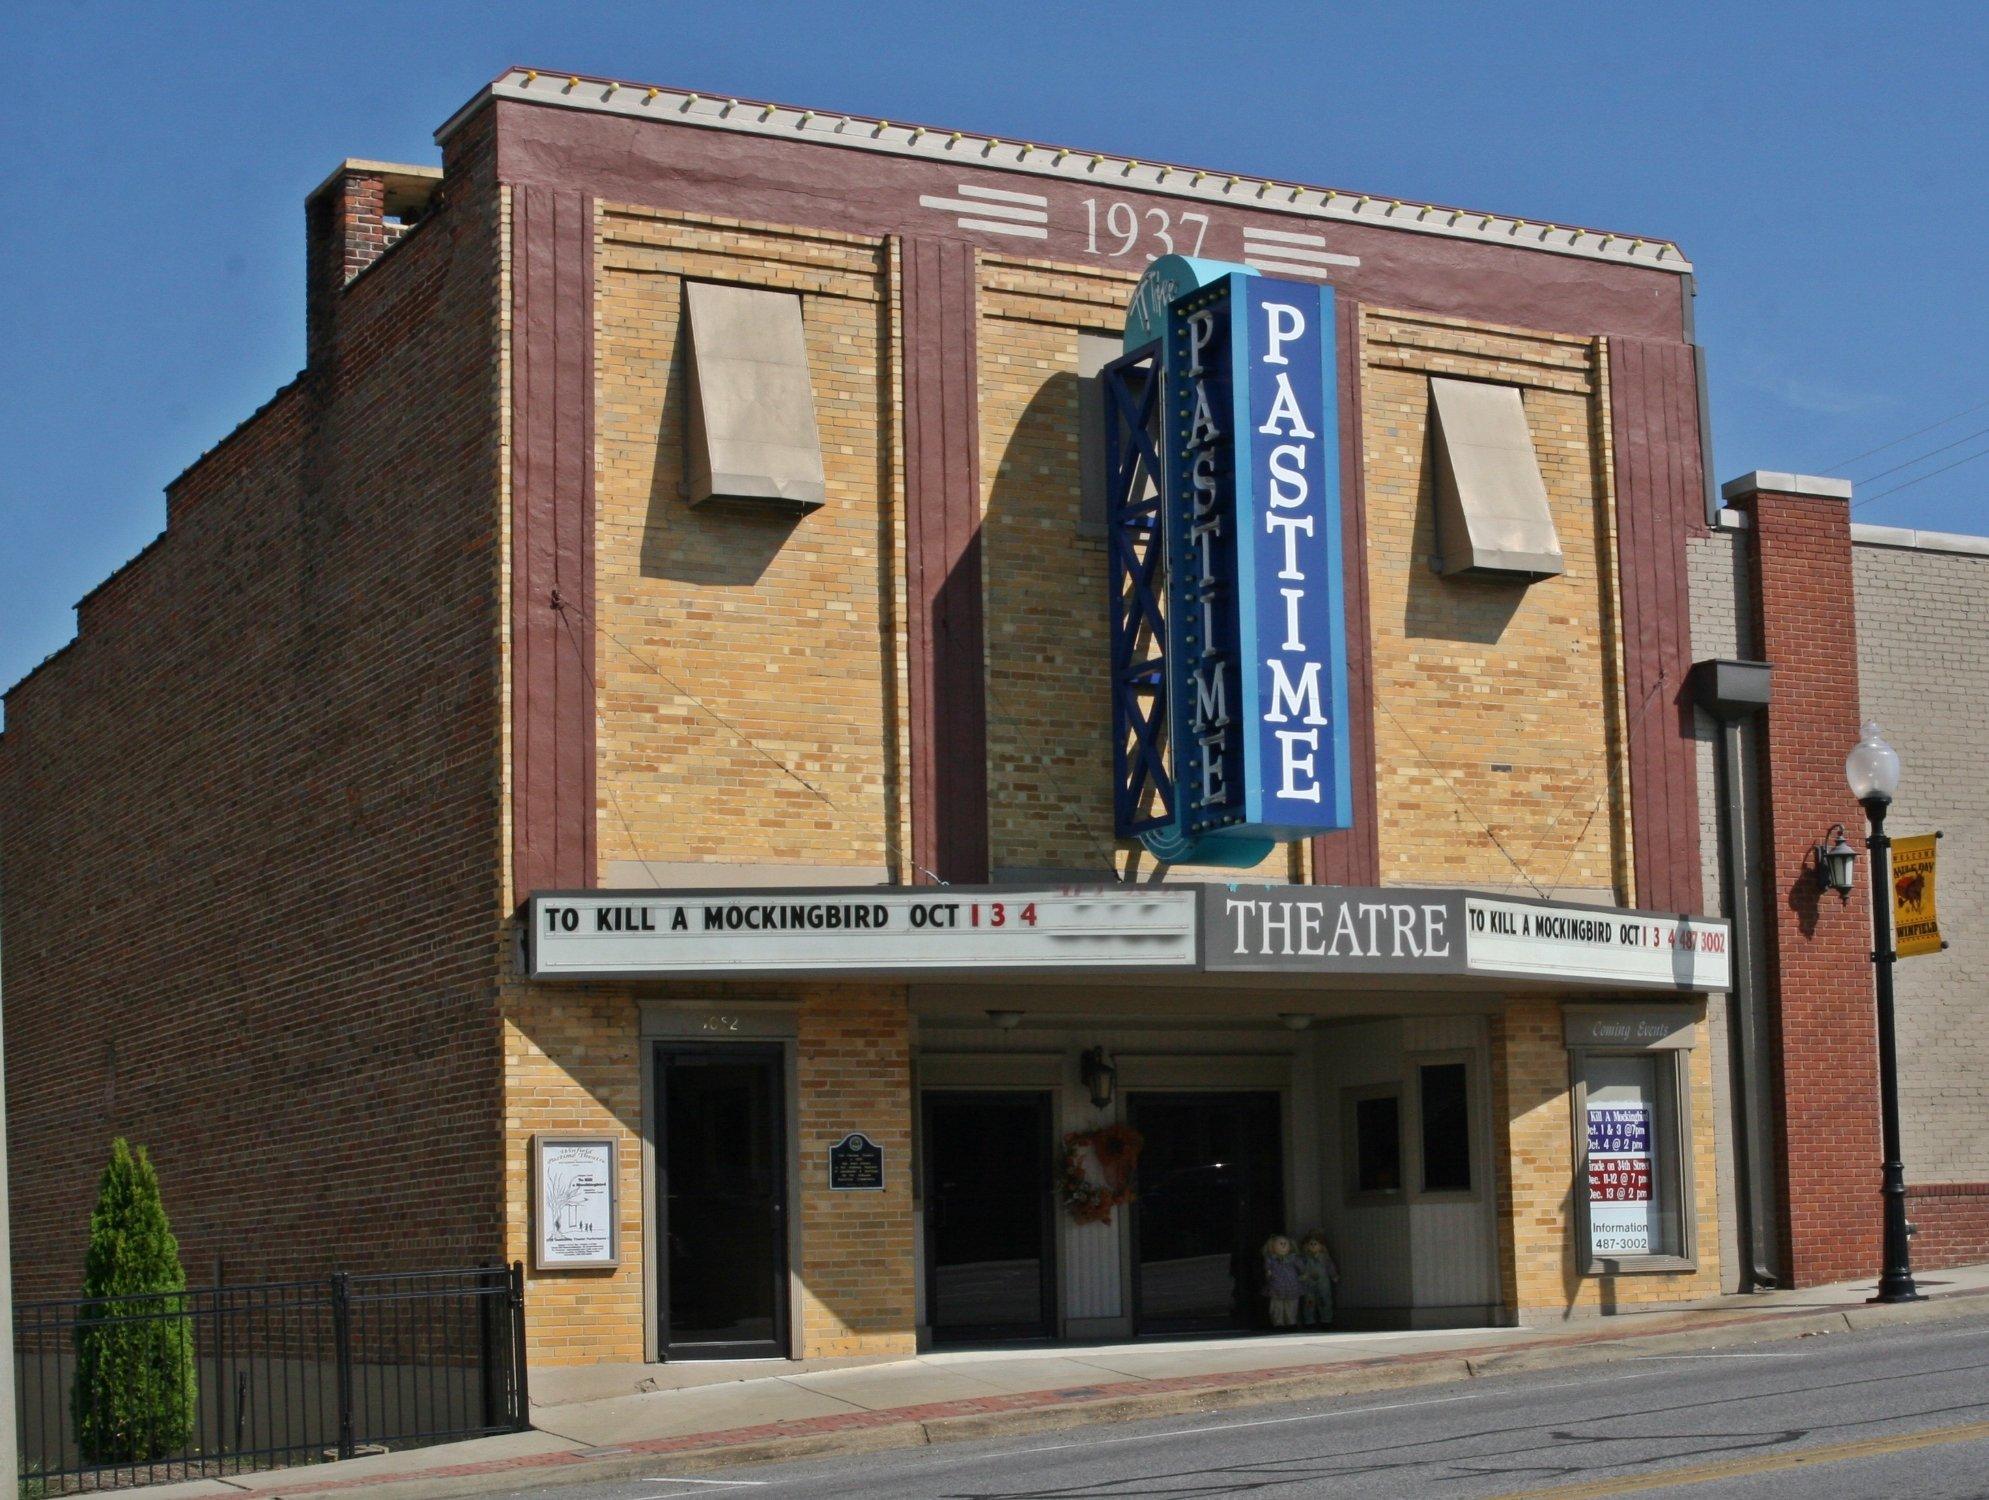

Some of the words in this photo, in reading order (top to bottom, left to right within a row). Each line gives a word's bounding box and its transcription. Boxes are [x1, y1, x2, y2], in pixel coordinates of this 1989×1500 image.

[1082, 198, 1209, 260] 1937
[1186, 310, 1227, 807] PASTIME
[1259, 301, 1328, 804] PASTIME
[545, 907, 579, 932] TO
[597, 906, 655, 931] KILL
[671, 907, 688, 931] A
[705, 904, 889, 931] MOCKINGBIRD
[910, 904, 960, 928] OCT
[971, 903, 979, 928] 1
[990, 903, 1006, 927] 3
[1020, 903, 1037, 927] 4
[1226, 898, 1450, 958] THEATRE
[1469, 908, 1485, 932] TO
[1490, 910, 1517, 935] KILL
[1523, 914, 1530, 936] A
[1535, 915, 1612, 943] MOCKINGBIRD
[1620, 924, 1640, 945] OCT
[1654, 927, 1660, 947] 3
[1667, 927, 1675, 948] 4
[1679, 930, 1698, 951] 487
[1895, 921, 1938, 938] WINFIELD
[1593, 1021, 1631, 1040] Coming
[1637, 1021, 1669, 1037] Events
[1605, 1111, 1611, 1121] A
[1601, 1124, 1604, 1135] 1
[1616, 1124, 1621, 1135] 3
[1603, 1139, 1609, 1149] 4
[1623, 1139, 1629, 1149] 2
[1632, 1141, 1643, 1152] pm
[1589, 1175, 1600, 1184] ec.
[1630, 1173, 1636, 1184] 7
[1606, 1188, 1614, 1199] 13
[1628, 1188, 1634, 1198] 2
[1636, 1189, 1647, 1201] pm
[1593, 1222, 1649, 1233] Information
[1596, 1238, 1647, 1249] 487-3002
